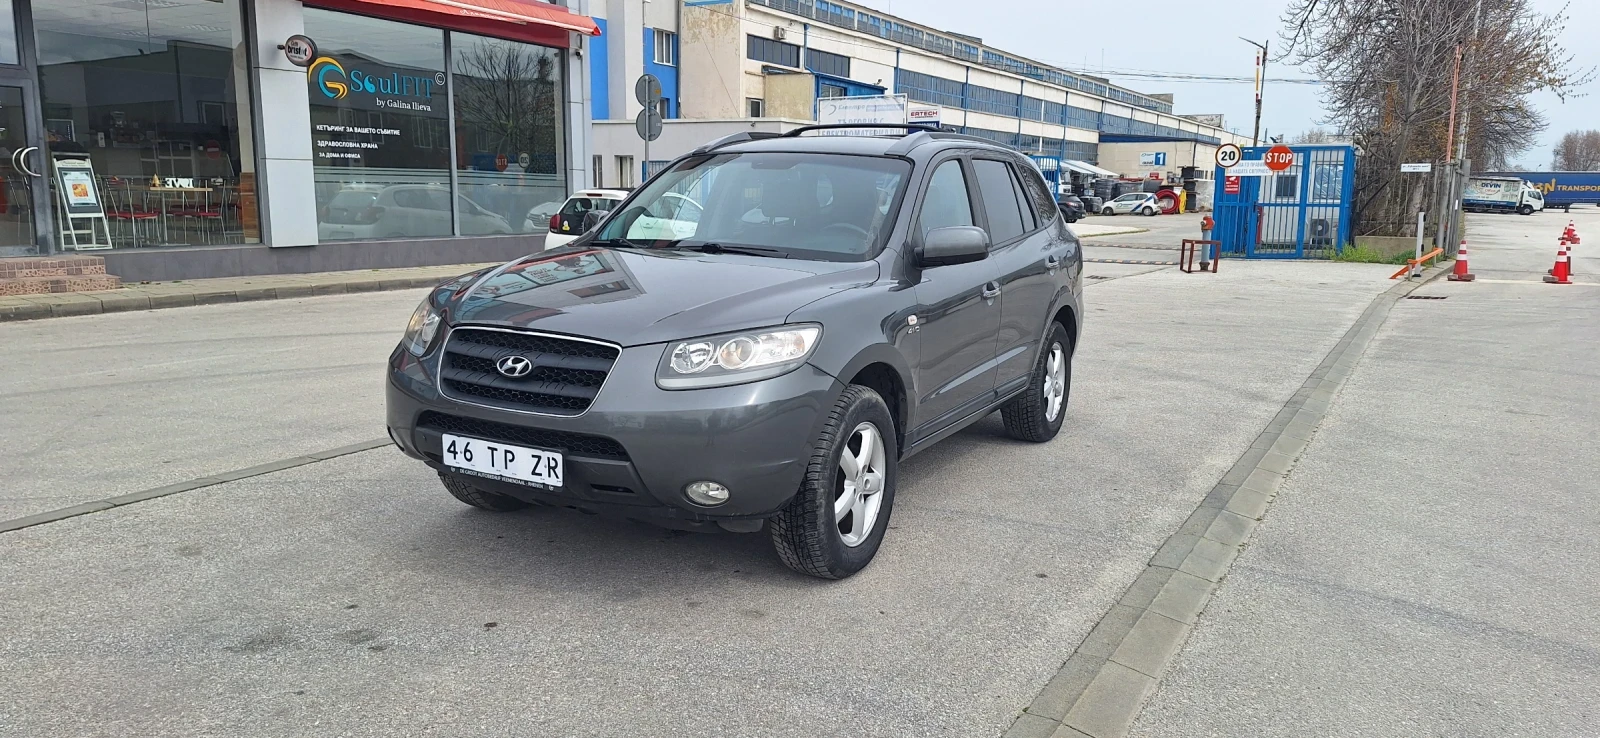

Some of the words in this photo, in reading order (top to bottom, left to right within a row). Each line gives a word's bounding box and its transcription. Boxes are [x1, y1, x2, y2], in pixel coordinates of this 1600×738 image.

[376, 97, 386, 109] by
[387, 99, 411, 110] Galina
[412, 102, 432, 112] Ilieva
[316, 124, 345, 132] КЕТЪРИНГ
[376, 128, 401, 136] СЪБИТИЕ
[317, 140, 360, 149] ЗДРАВОСЛОВНА
[1157, 153, 1164, 165] 1
[1220, 150, 1236, 161] 20
[1266, 152, 1293, 164] STOP
[487, 446, 515, 470] TP
[531, 454, 559, 479] ZR
